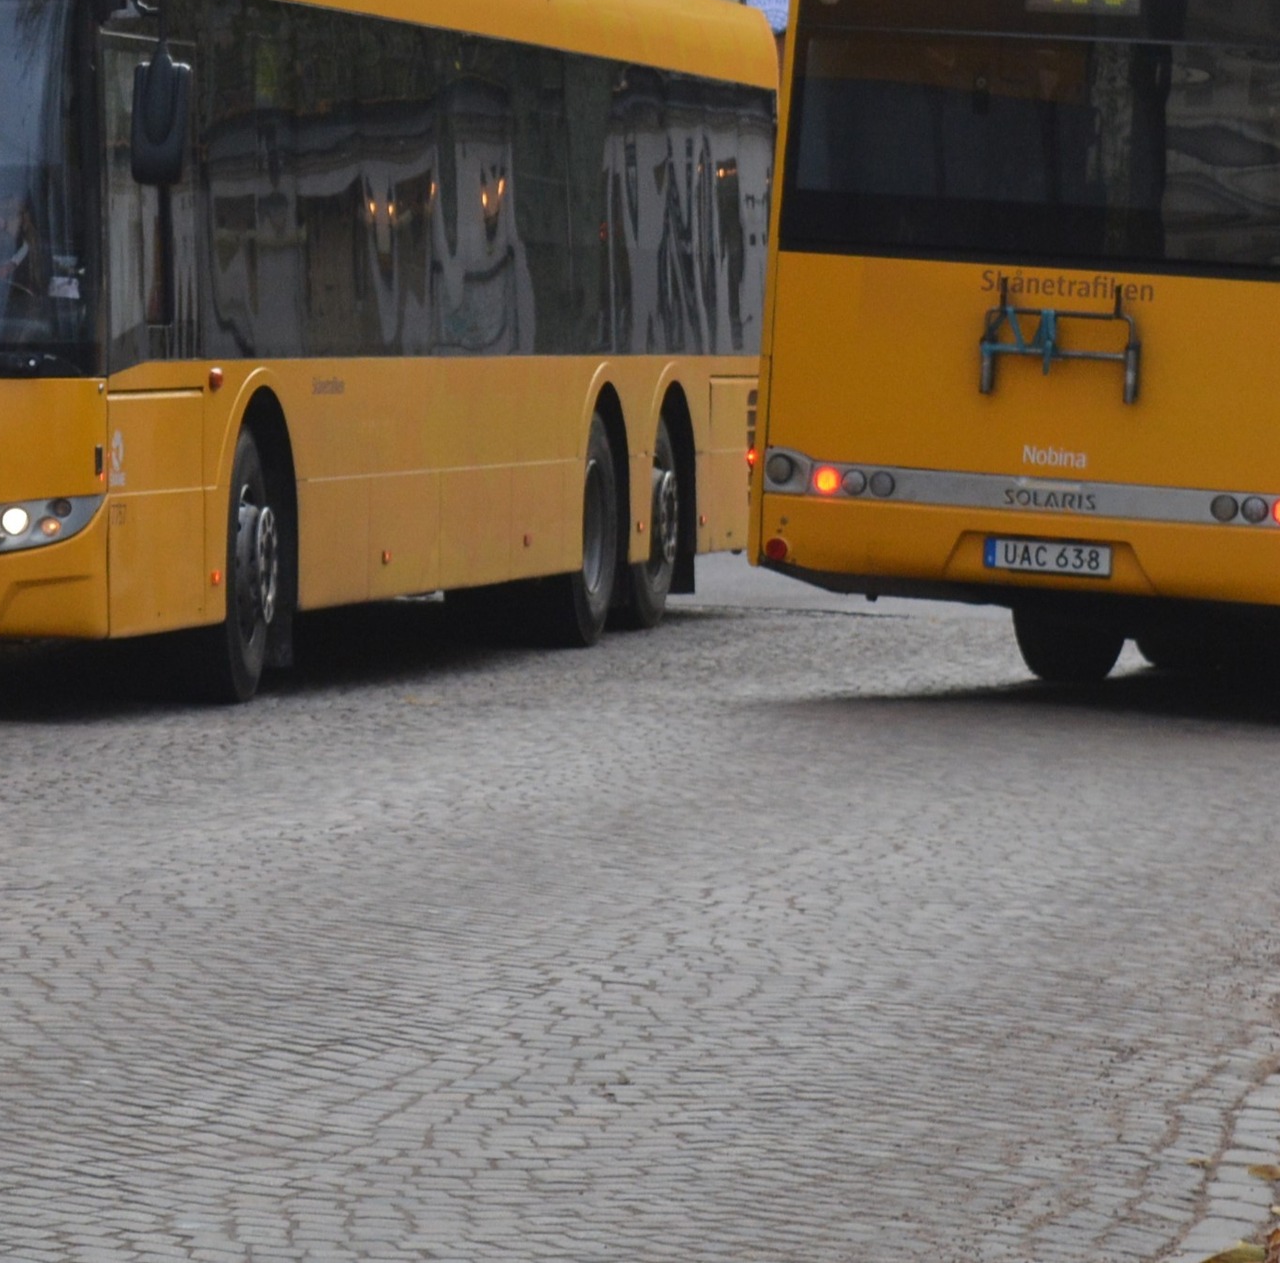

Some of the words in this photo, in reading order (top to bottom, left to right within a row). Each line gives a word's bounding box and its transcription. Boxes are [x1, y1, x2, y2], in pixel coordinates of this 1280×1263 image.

[1022, 444, 1087, 469] Nobina
[1004, 488, 1096, 511] SOLARIS
[1004, 542, 1048, 567] UAC
[1055, 547, 1100, 571] 638
